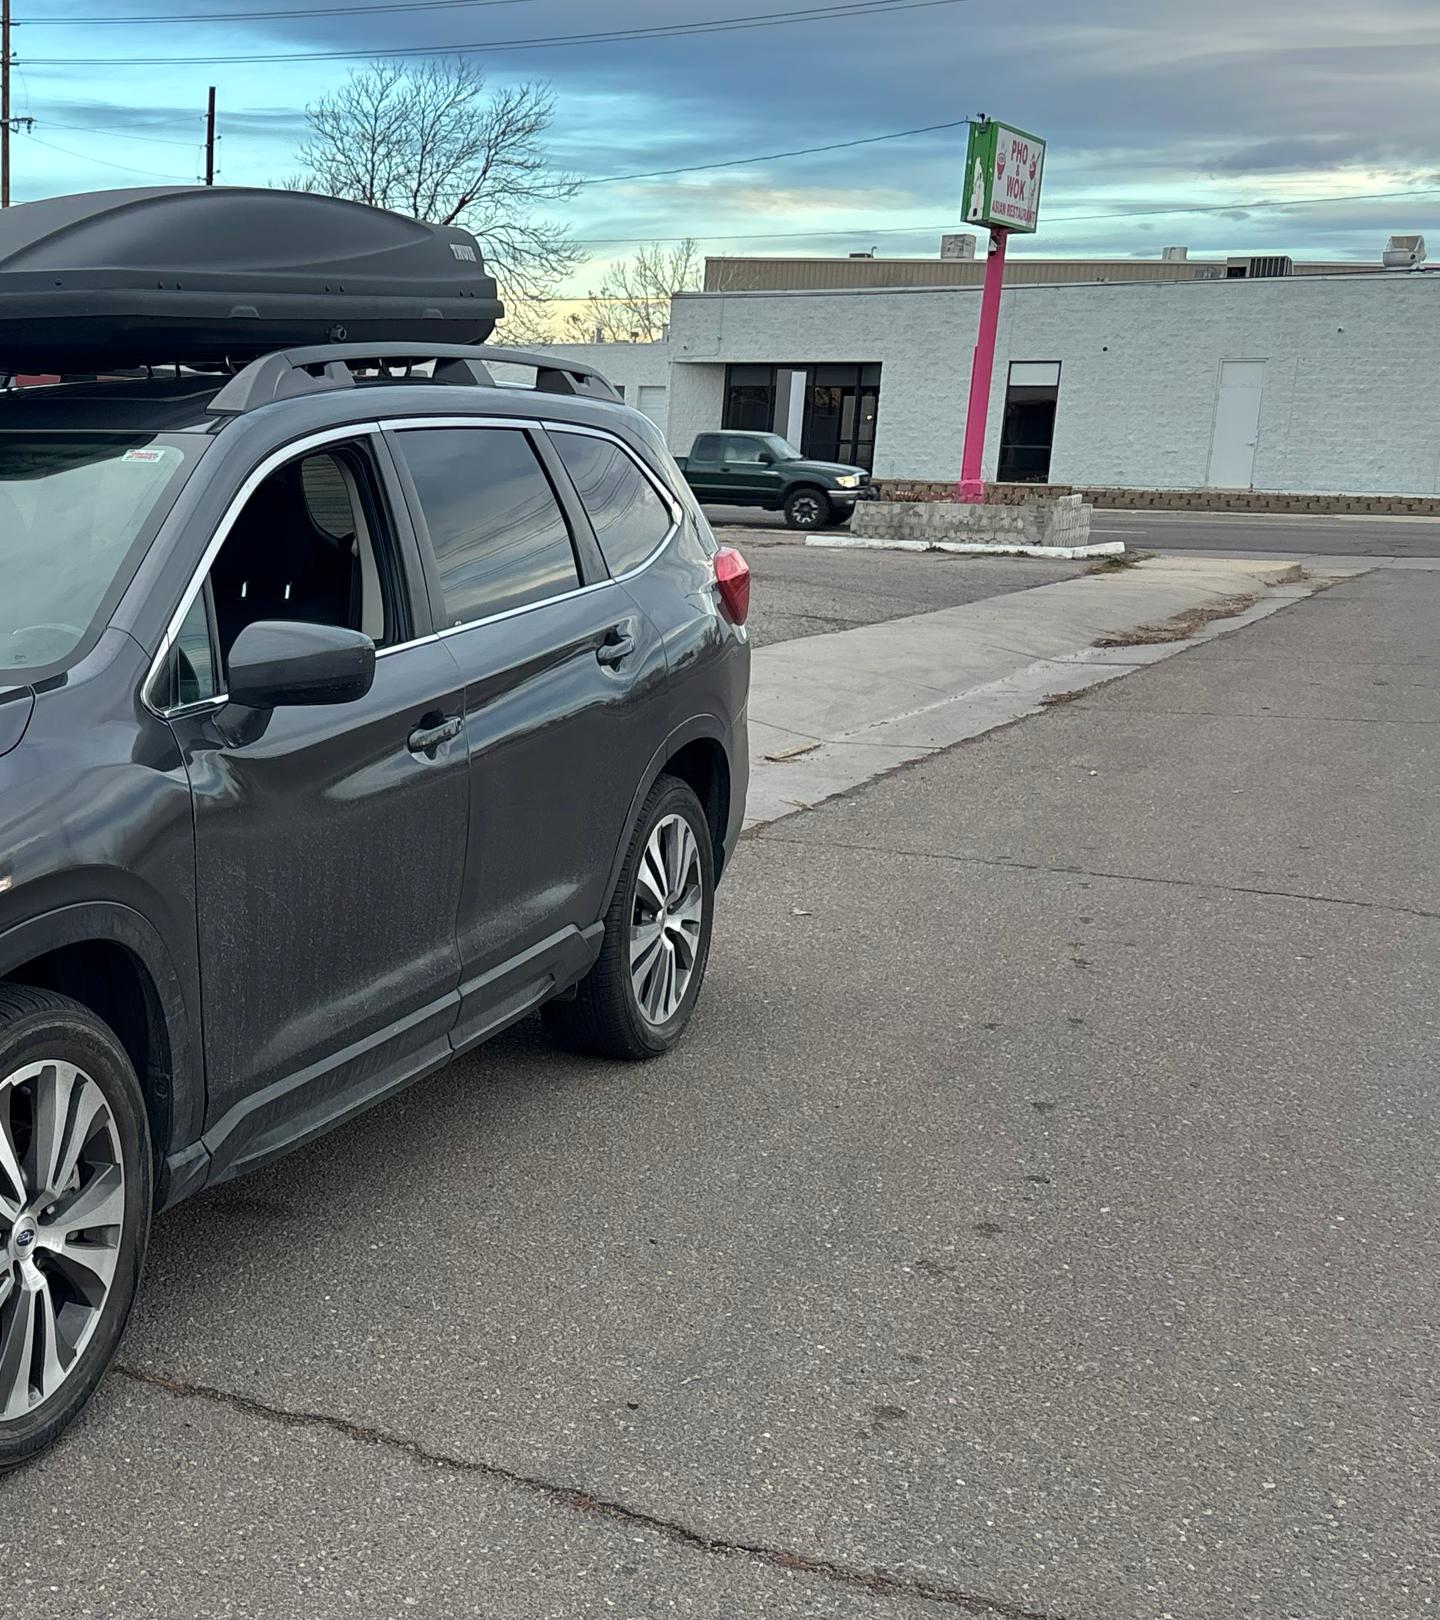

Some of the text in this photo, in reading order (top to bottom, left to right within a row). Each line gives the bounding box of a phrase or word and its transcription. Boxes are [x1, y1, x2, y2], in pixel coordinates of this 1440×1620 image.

[1011, 140, 1028, 166] PHO
[1006, 175, 1026, 202] WOK
[991, 200, 1007, 216] ASIAN
